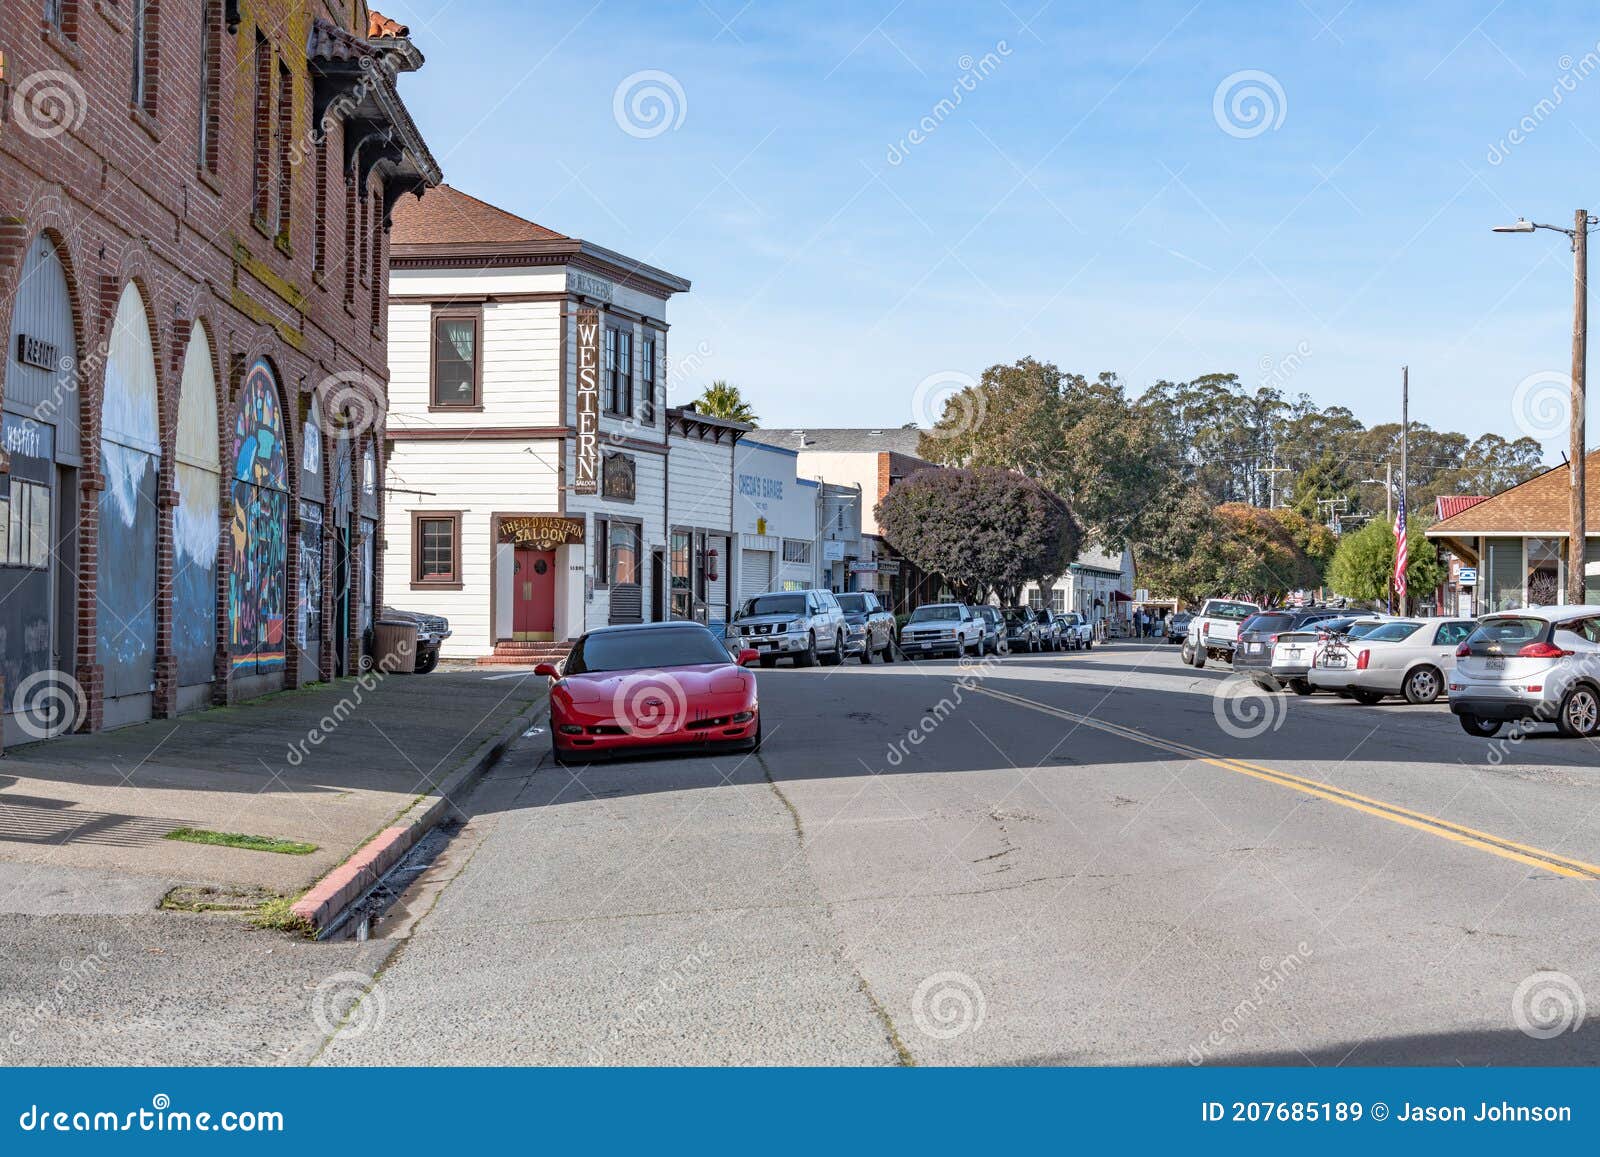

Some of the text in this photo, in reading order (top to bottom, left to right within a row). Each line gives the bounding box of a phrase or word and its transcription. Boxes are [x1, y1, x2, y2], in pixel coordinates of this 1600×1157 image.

[578, 324, 598, 479] WESTERN
[501, 520, 519, 535] THE
[540, 518, 584, 538] WESTERN
[516, 528, 567, 543] SALOON
